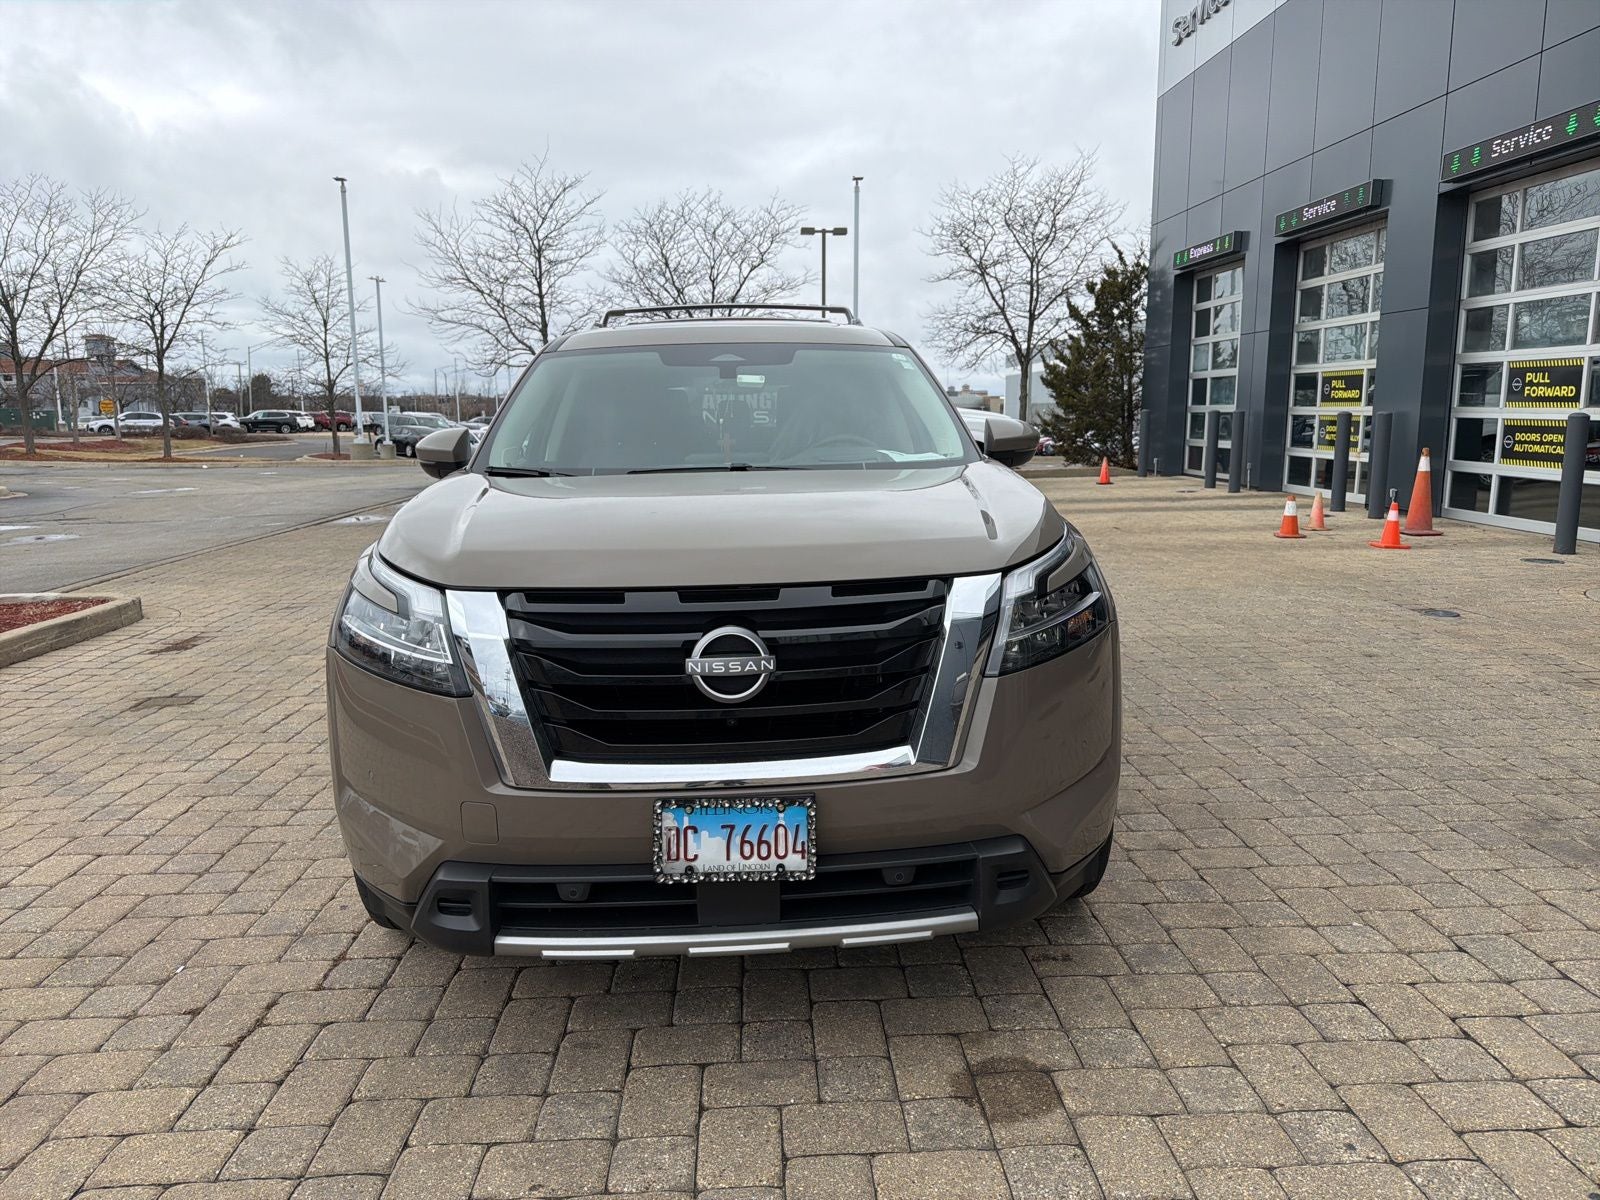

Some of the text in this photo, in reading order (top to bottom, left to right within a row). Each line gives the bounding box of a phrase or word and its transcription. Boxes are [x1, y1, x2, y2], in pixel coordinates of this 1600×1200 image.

[1491, 125, 1552, 157] Service
[1303, 199, 1336, 221] Service
[1189, 244, 1214, 258] Express
[1331, 379, 1346, 388] PULL
[1525, 372, 1550, 384] PULL
[1330, 389, 1360, 399] FORWARD
[1524, 386, 1576, 397] FORWARD
[1515, 433, 1541, 442] DOORS
[1542, 433, 1564, 443] OPEN
[688, 659, 774, 673] NISSAN
[720, 824, 807, 861] 76604
[702, 863, 771, 872] LAND OF LINCOLN
